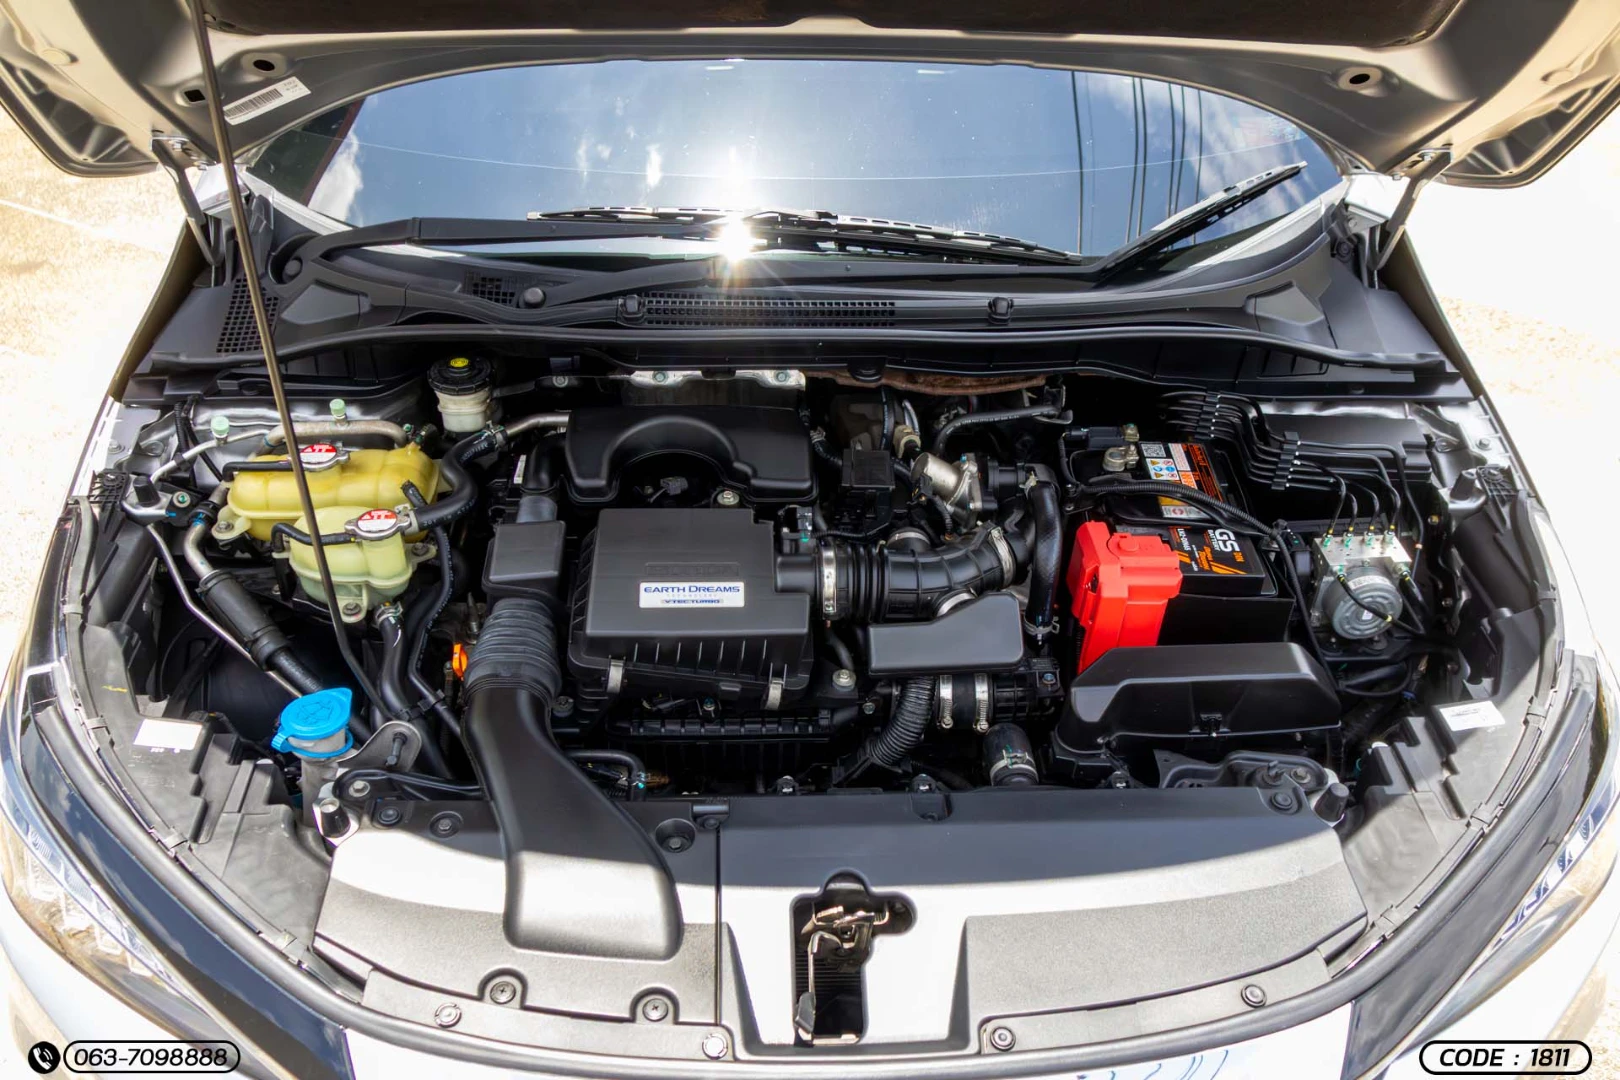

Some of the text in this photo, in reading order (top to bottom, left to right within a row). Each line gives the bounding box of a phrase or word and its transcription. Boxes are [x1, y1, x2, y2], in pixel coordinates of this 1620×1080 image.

[1207, 529, 1221, 551] BATTERY
[1214, 528, 1240, 552] GS
[688, 585, 740, 593] DREAMS
